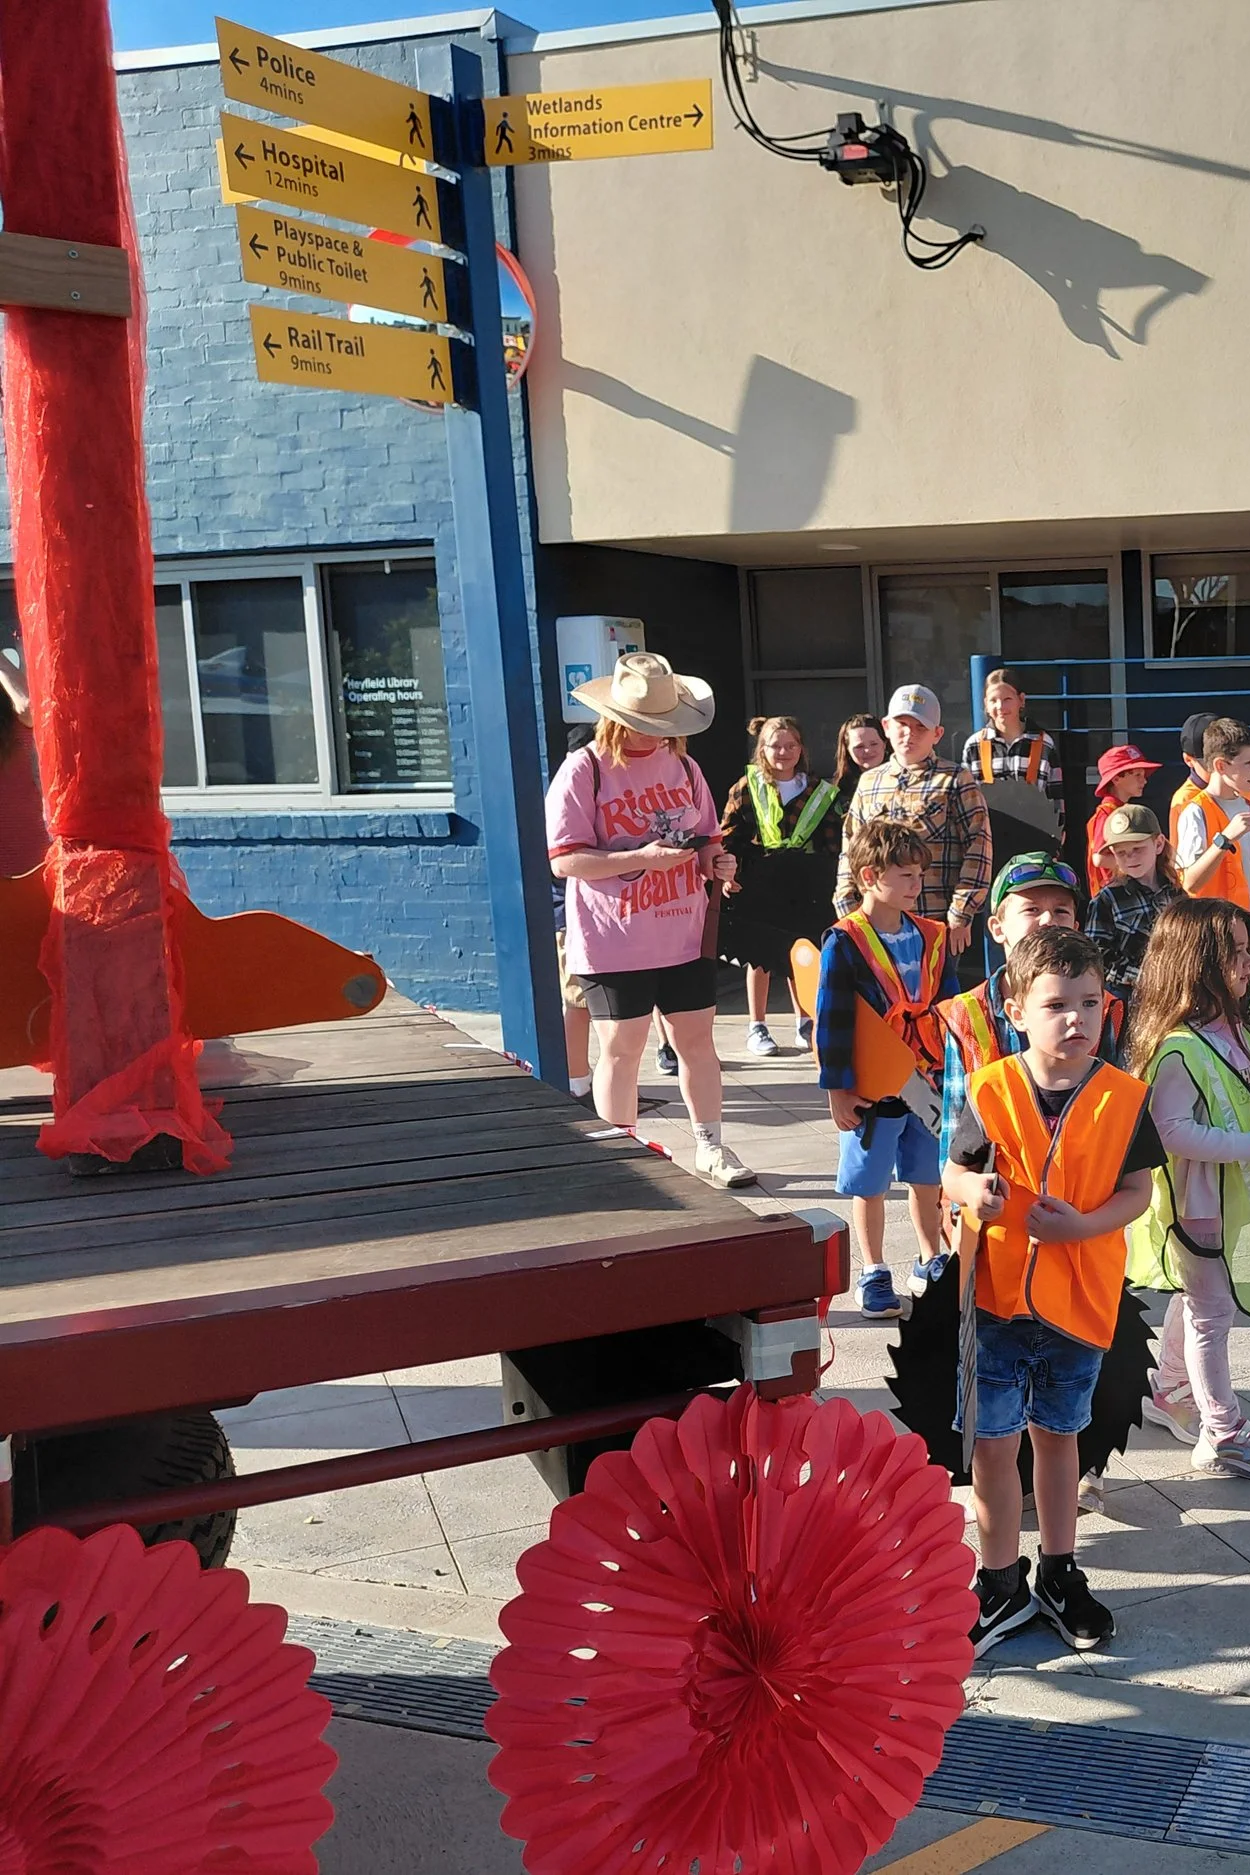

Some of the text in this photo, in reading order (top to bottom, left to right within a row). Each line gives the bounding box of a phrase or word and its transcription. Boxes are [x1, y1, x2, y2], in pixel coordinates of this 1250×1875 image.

[256, 46, 316, 87] Police
[259, 76, 304, 105] 4mins
[526, 94, 603, 116] Wetlands
[528, 113, 683, 140] Information Centre
[261, 140, 345, 183] Hospital
[527, 144, 573, 161] 3mins
[265, 169, 319, 197] 12mins
[273, 219, 364, 258] Playspace &
[276, 246, 369, 283] Public Toilet
[278, 270, 322, 294] 9mins
[287, 326, 366, 357] Rail Trail
[290, 355, 332, 375] 9mins
[347, 677, 419, 691] Heyfield Library
[348, 690, 424, 703] Operating hours
[600, 780, 692, 839] Ridin'
[654, 907, 692, 918] FESTIVAL
